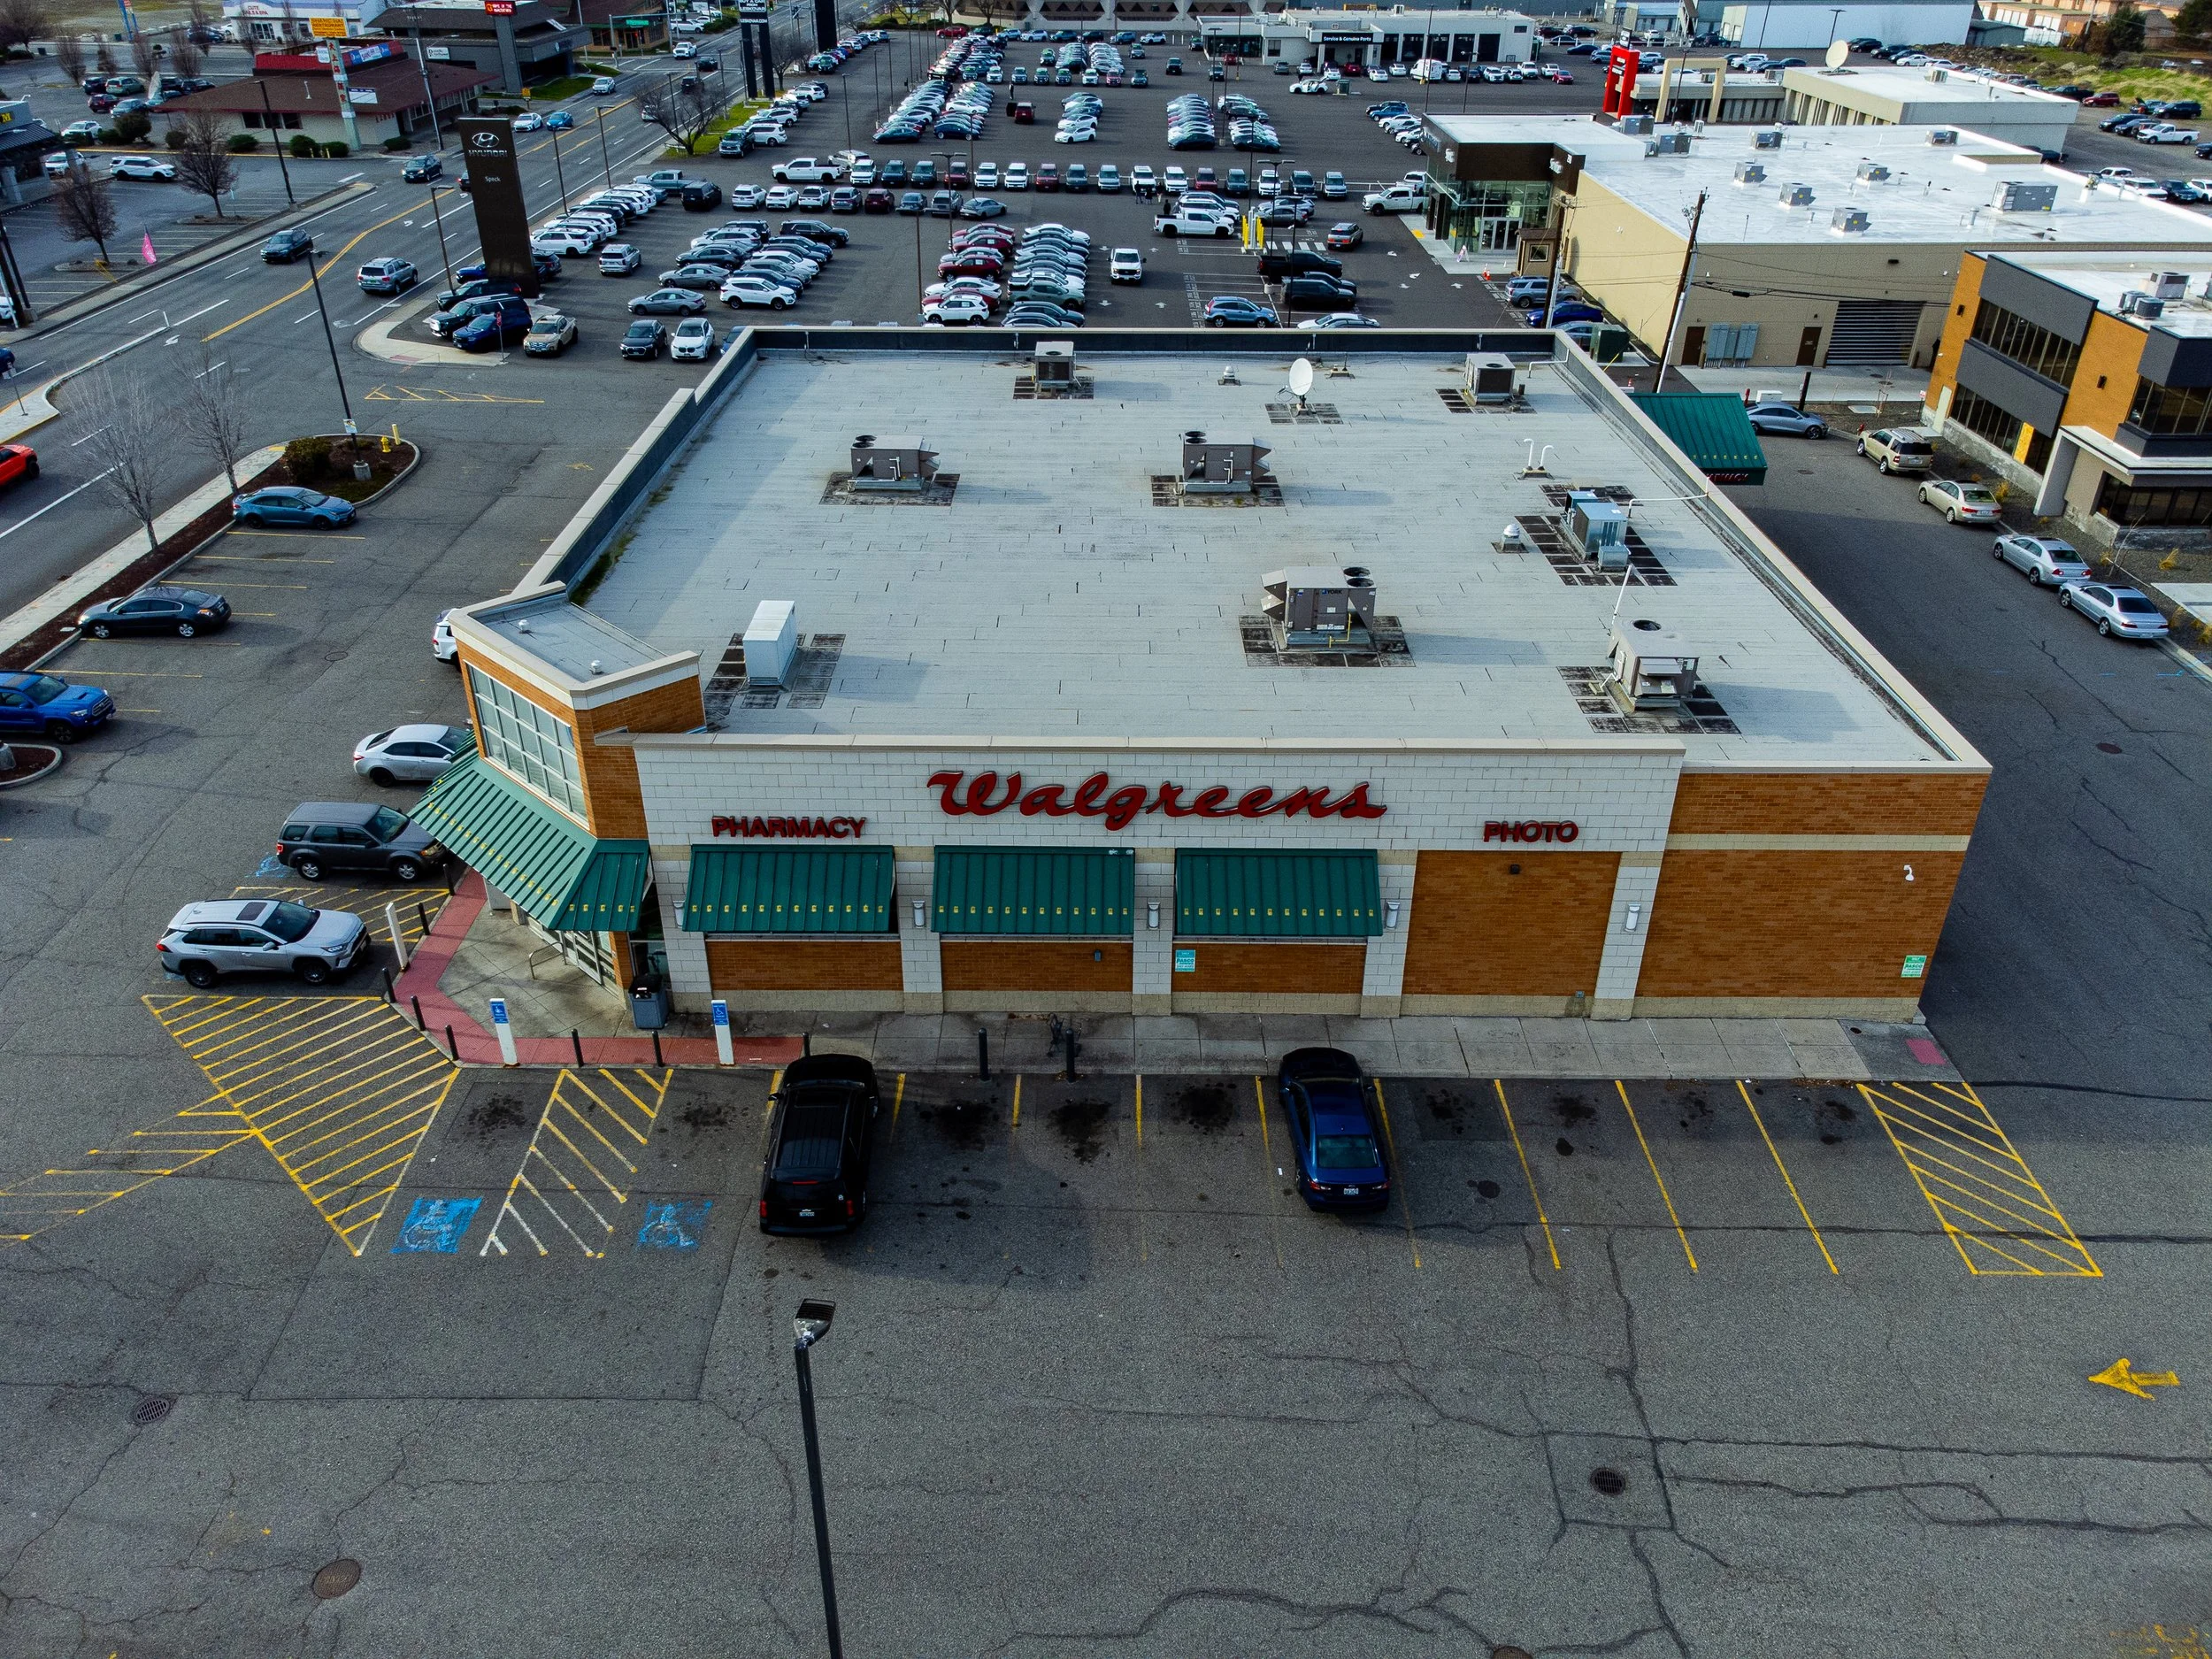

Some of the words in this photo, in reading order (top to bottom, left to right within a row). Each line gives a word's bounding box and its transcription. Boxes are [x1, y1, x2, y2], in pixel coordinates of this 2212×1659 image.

[927, 771, 1386, 830] Walgreens
[712, 817, 865, 838] PHARMACY
[1484, 821, 1578, 842] PHOTO
